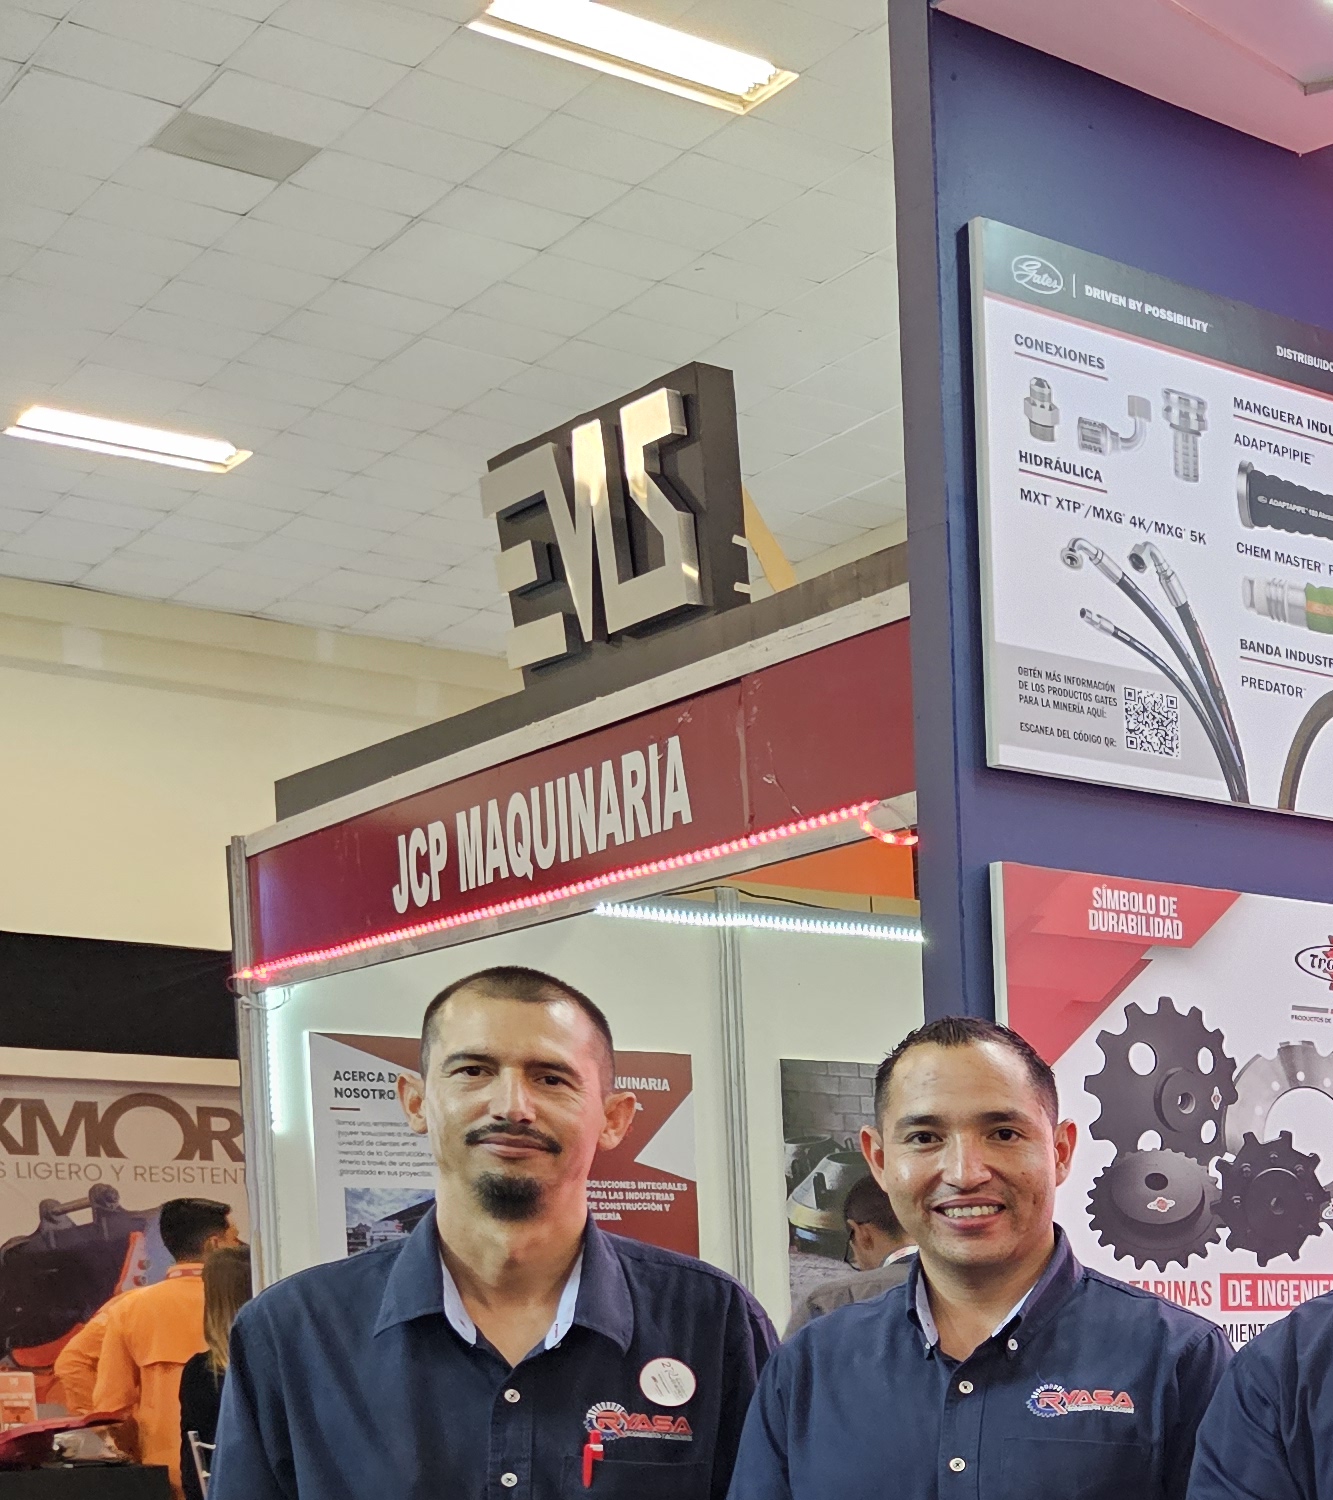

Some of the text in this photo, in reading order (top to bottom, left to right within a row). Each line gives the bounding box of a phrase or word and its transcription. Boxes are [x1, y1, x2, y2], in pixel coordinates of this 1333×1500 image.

[1015, 261, 1061, 290] Gates
[1085, 285, 1208, 333] DRIVEN BY POSSIBILITY
[1014, 333, 1106, 370] CONEXIONES
[1233, 397, 1303, 427] MANGUERA
[1019, 450, 1103, 483] HIDRÁULICA
[1190, 530, 1207, 545] 5K
[1236, 542, 1271, 561] CHEM
[1275, 551, 1322, 573] MASTER
[1239, 638, 1283, 661] BANDA
[1018, 666, 1116, 693] OBTÉN MÁS INFORMACIÓN
[1240, 675, 1304, 699] PREDATOR
[1018, 680, 1118, 707] DE LOS PRODUCTOS GATES
[1018, 694, 1039, 706] PARA
[1041, 698, 1051, 708] LA
[1053, 700, 1085, 715] MINERÍA
[1020, 722, 1055, 737] ESCANEA
[1057, 728, 1070, 739] DEL
[1073, 729, 1102, 744] CÓDIGO
[391, 734, 693, 914] JCP MAQUINARIA
[1092, 884, 1178, 918] SÍMBOLO DE
[1088, 909, 1183, 941] DURABILIDAD
[1291, 1014, 1324, 1023] PRODUCTOS
[333, 1070, 398, 1083] ACERCA D
[615, 1076, 670, 1091] UINARIA
[334, 1087, 396, 1100] NOSOTRO
[16, 1162, 246, 1184] LIGERO Y RESISTENT
[638, 1181, 688, 1191] INTEGRALES
[600, 1201, 662, 1212] CONSTRUCCIÓN
[665, 1204, 670, 1212] Y
[609, 1191, 624, 1200] LAS
[626, 1191, 675, 1201] INDUSTRIAS
[1228, 1280, 1254, 1307] DE
[1038, 1389, 1135, 1415] RYASA
[596, 1411, 693, 1437] RYASA
